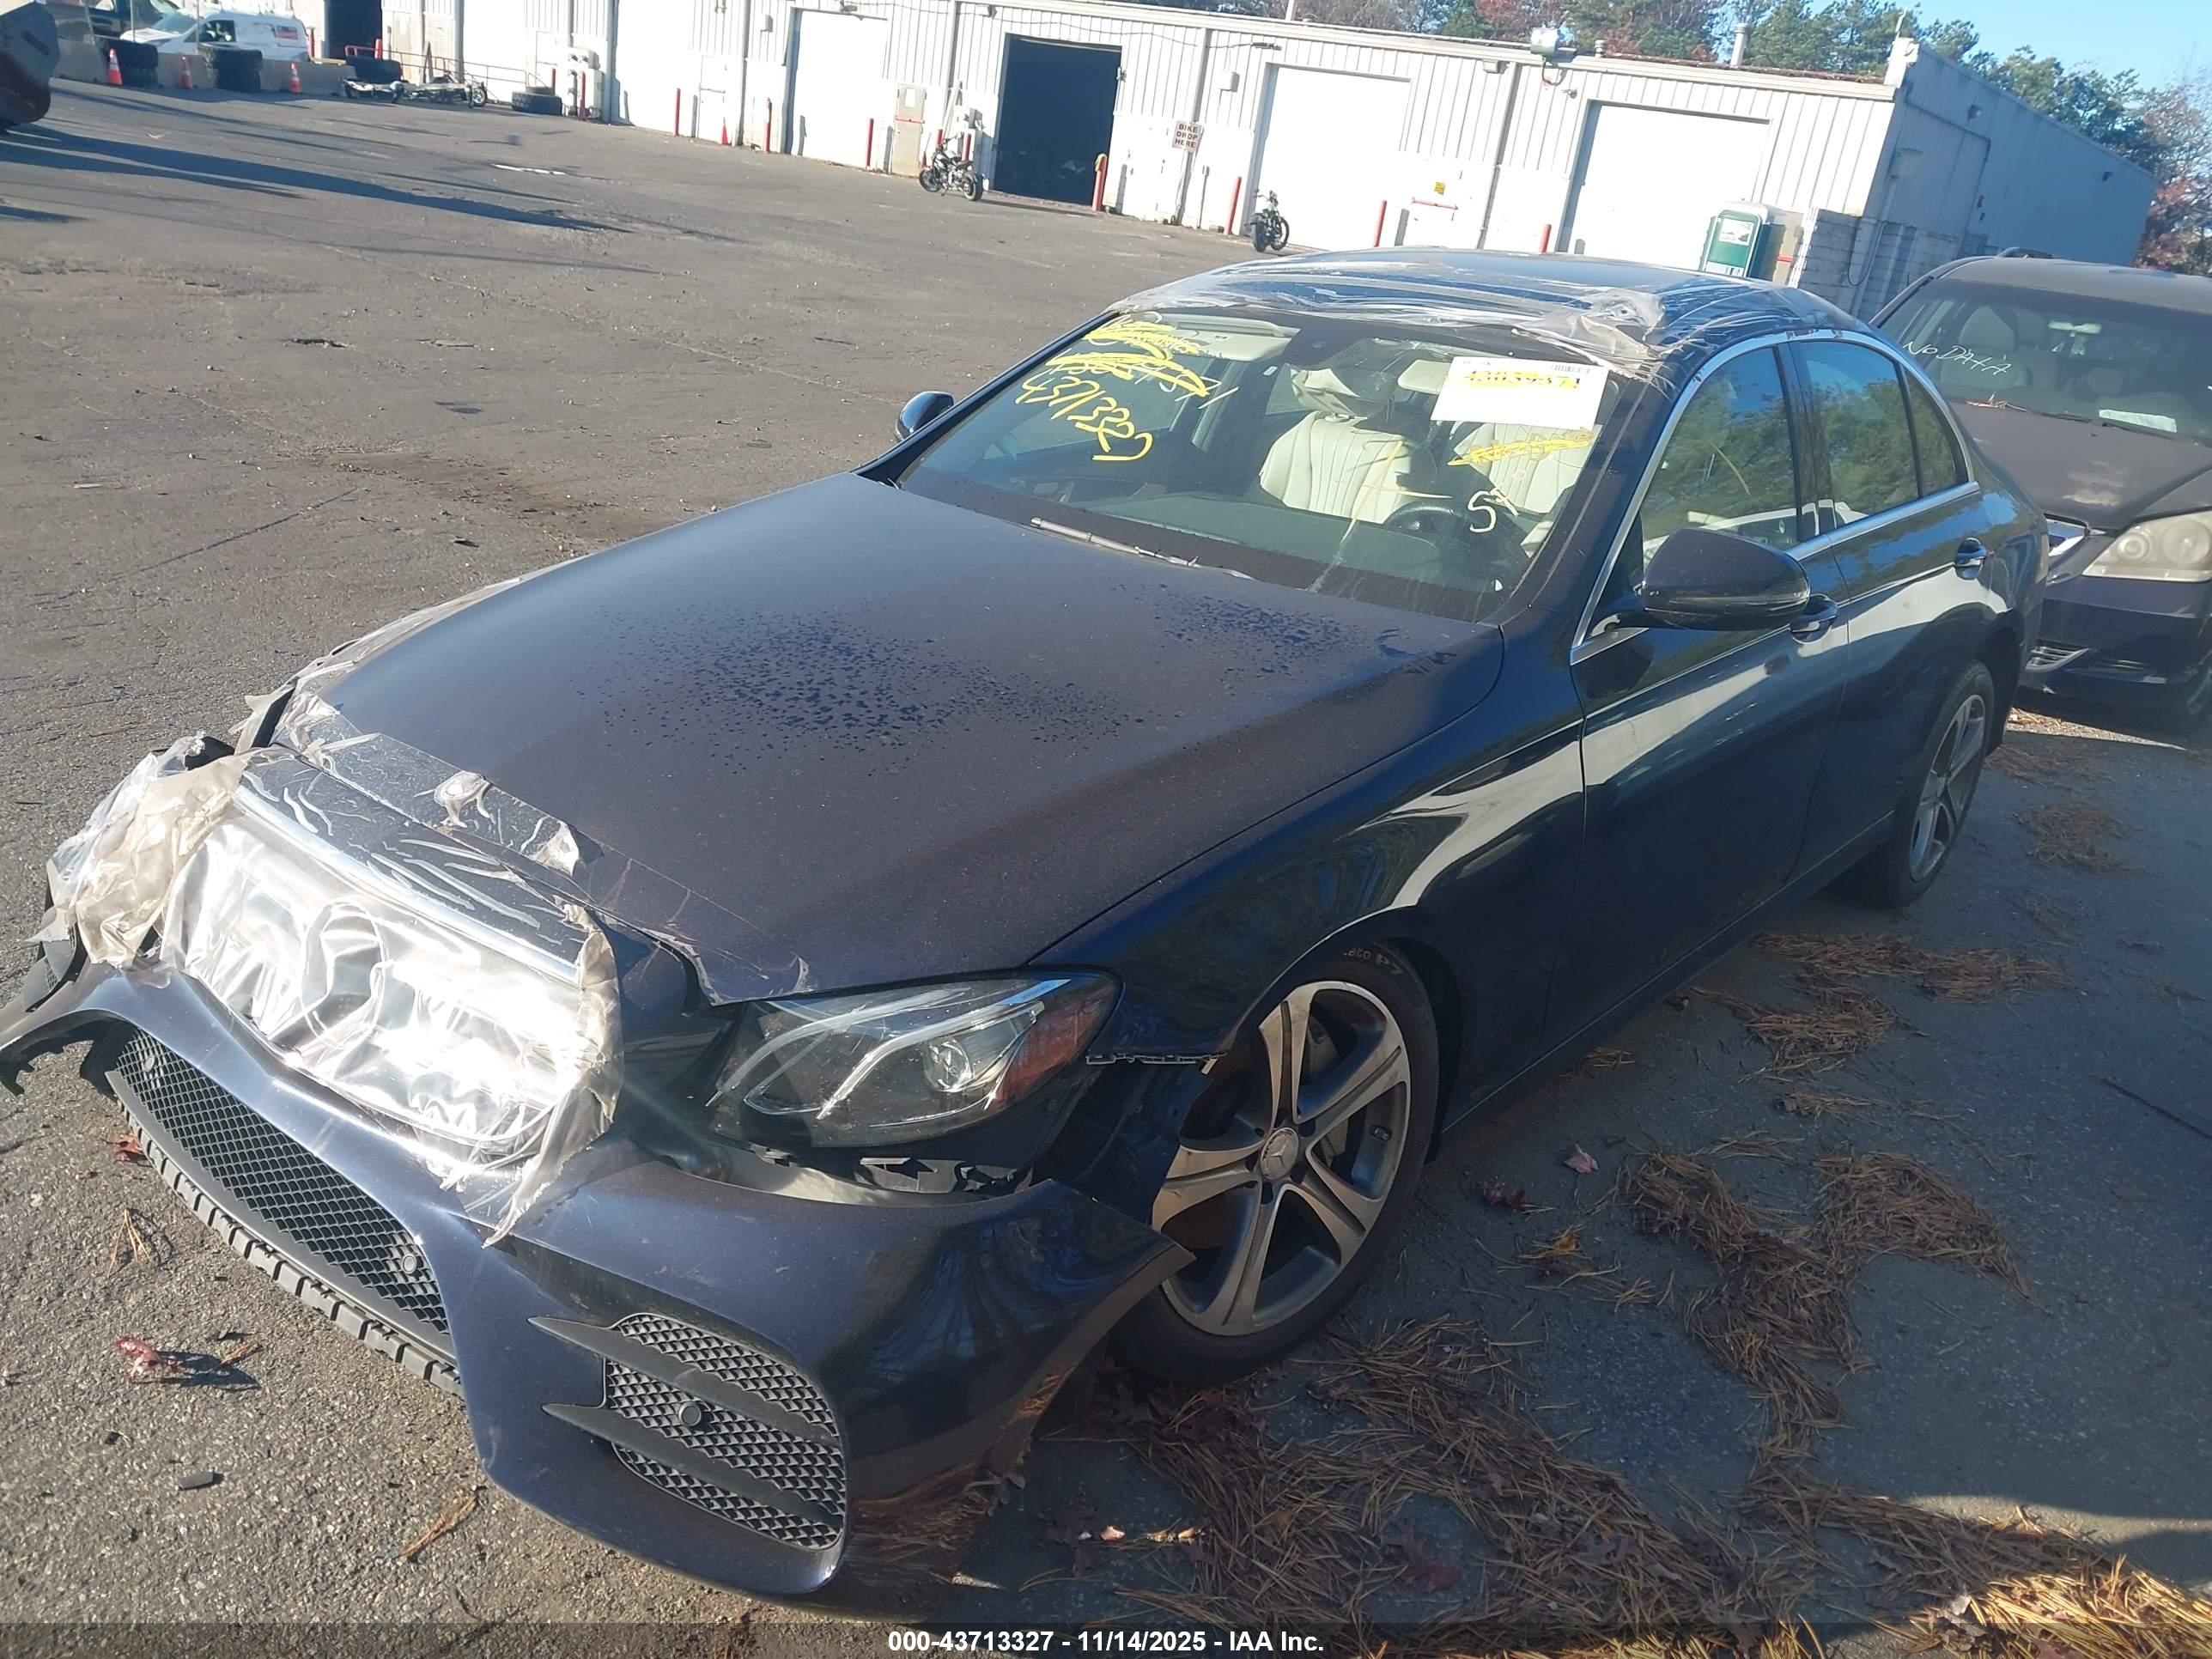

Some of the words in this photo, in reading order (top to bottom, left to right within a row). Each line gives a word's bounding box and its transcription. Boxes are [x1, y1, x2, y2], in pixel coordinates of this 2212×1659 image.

[1179, 123, 1198, 133] BIKE
[1176, 131, 1198, 141] DROP
[1175, 137, 1196, 149] HERE
[1374, 952, 1404, 975] P7
